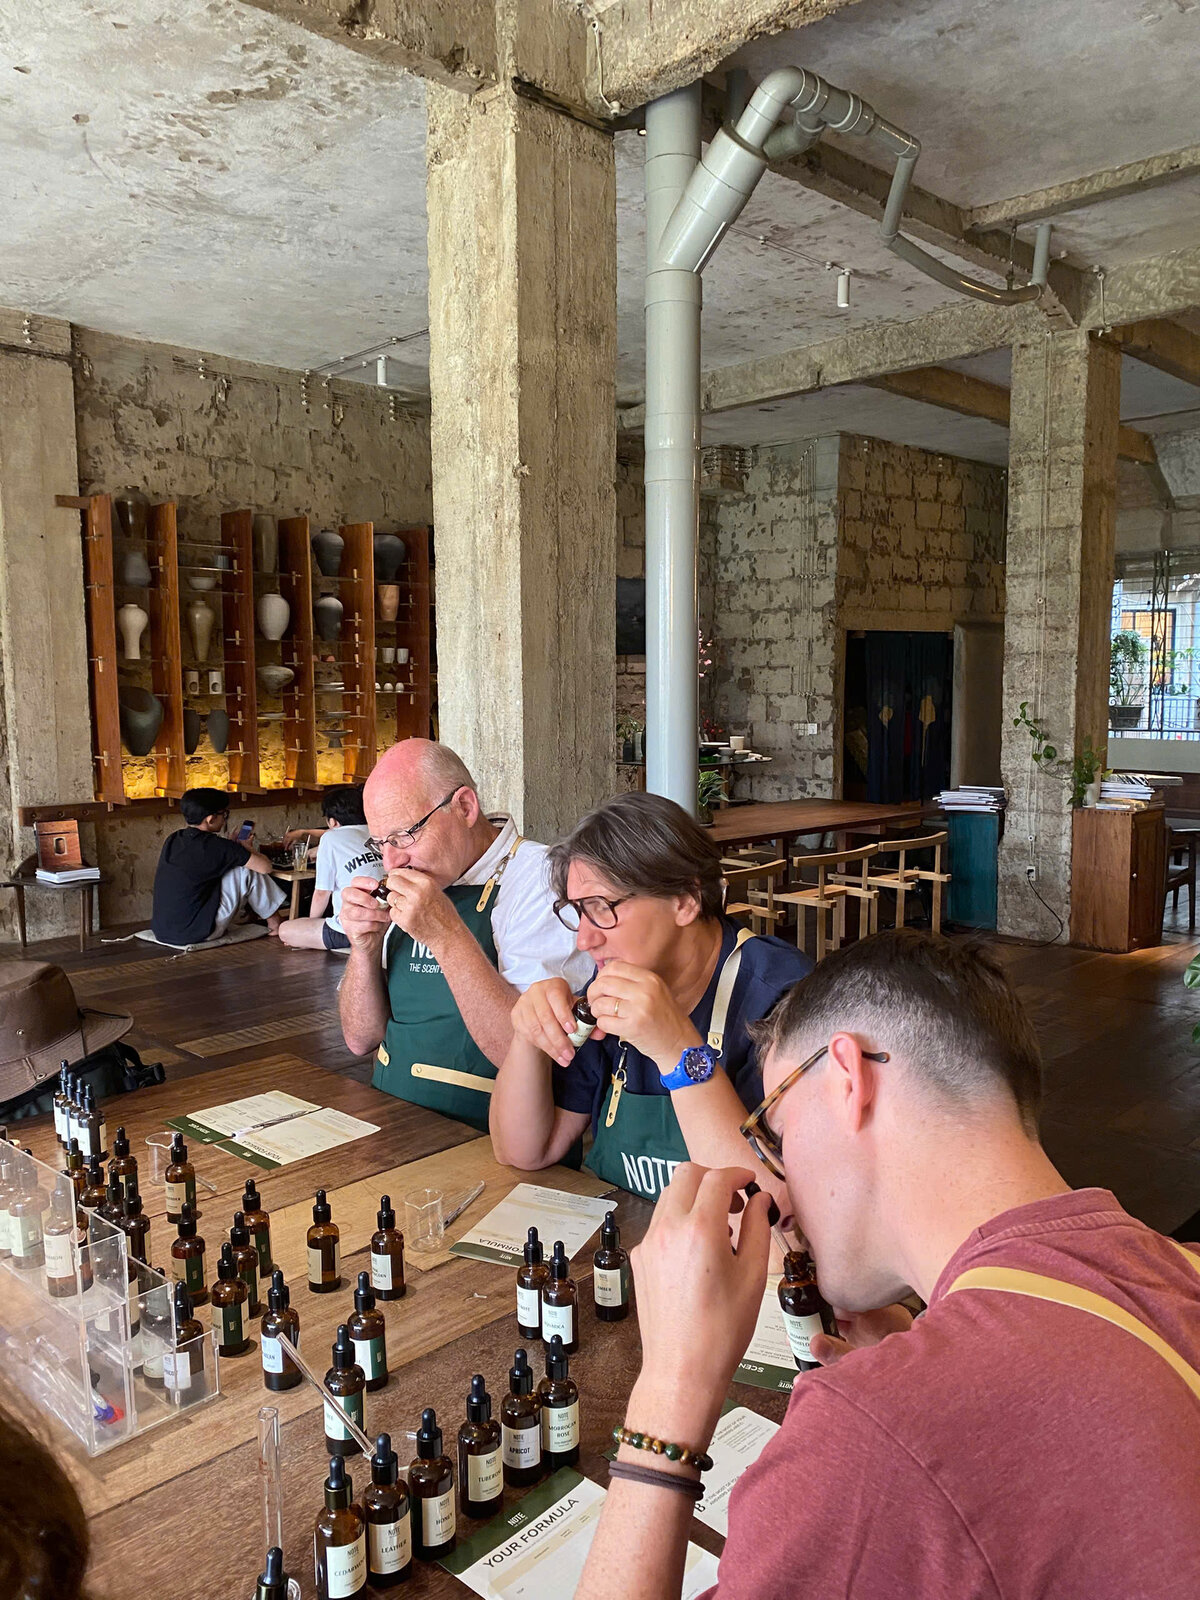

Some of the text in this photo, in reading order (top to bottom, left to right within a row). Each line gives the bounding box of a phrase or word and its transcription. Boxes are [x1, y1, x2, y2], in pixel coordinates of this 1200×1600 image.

[409, 963, 421, 973] THE
[421, 964, 440, 974] SCENT
[738, 1363, 765, 1373] SCEN
[509, 1447, 530, 1455] APRICOT
[694, 1503, 706, 1513] B
[435, 1512, 453, 1525] HONEY
[507, 1511, 526, 1526] NOTE
[483, 1499, 579, 1568] YOUR FORMULA
[381, 1539, 407, 1554] LEATHER
